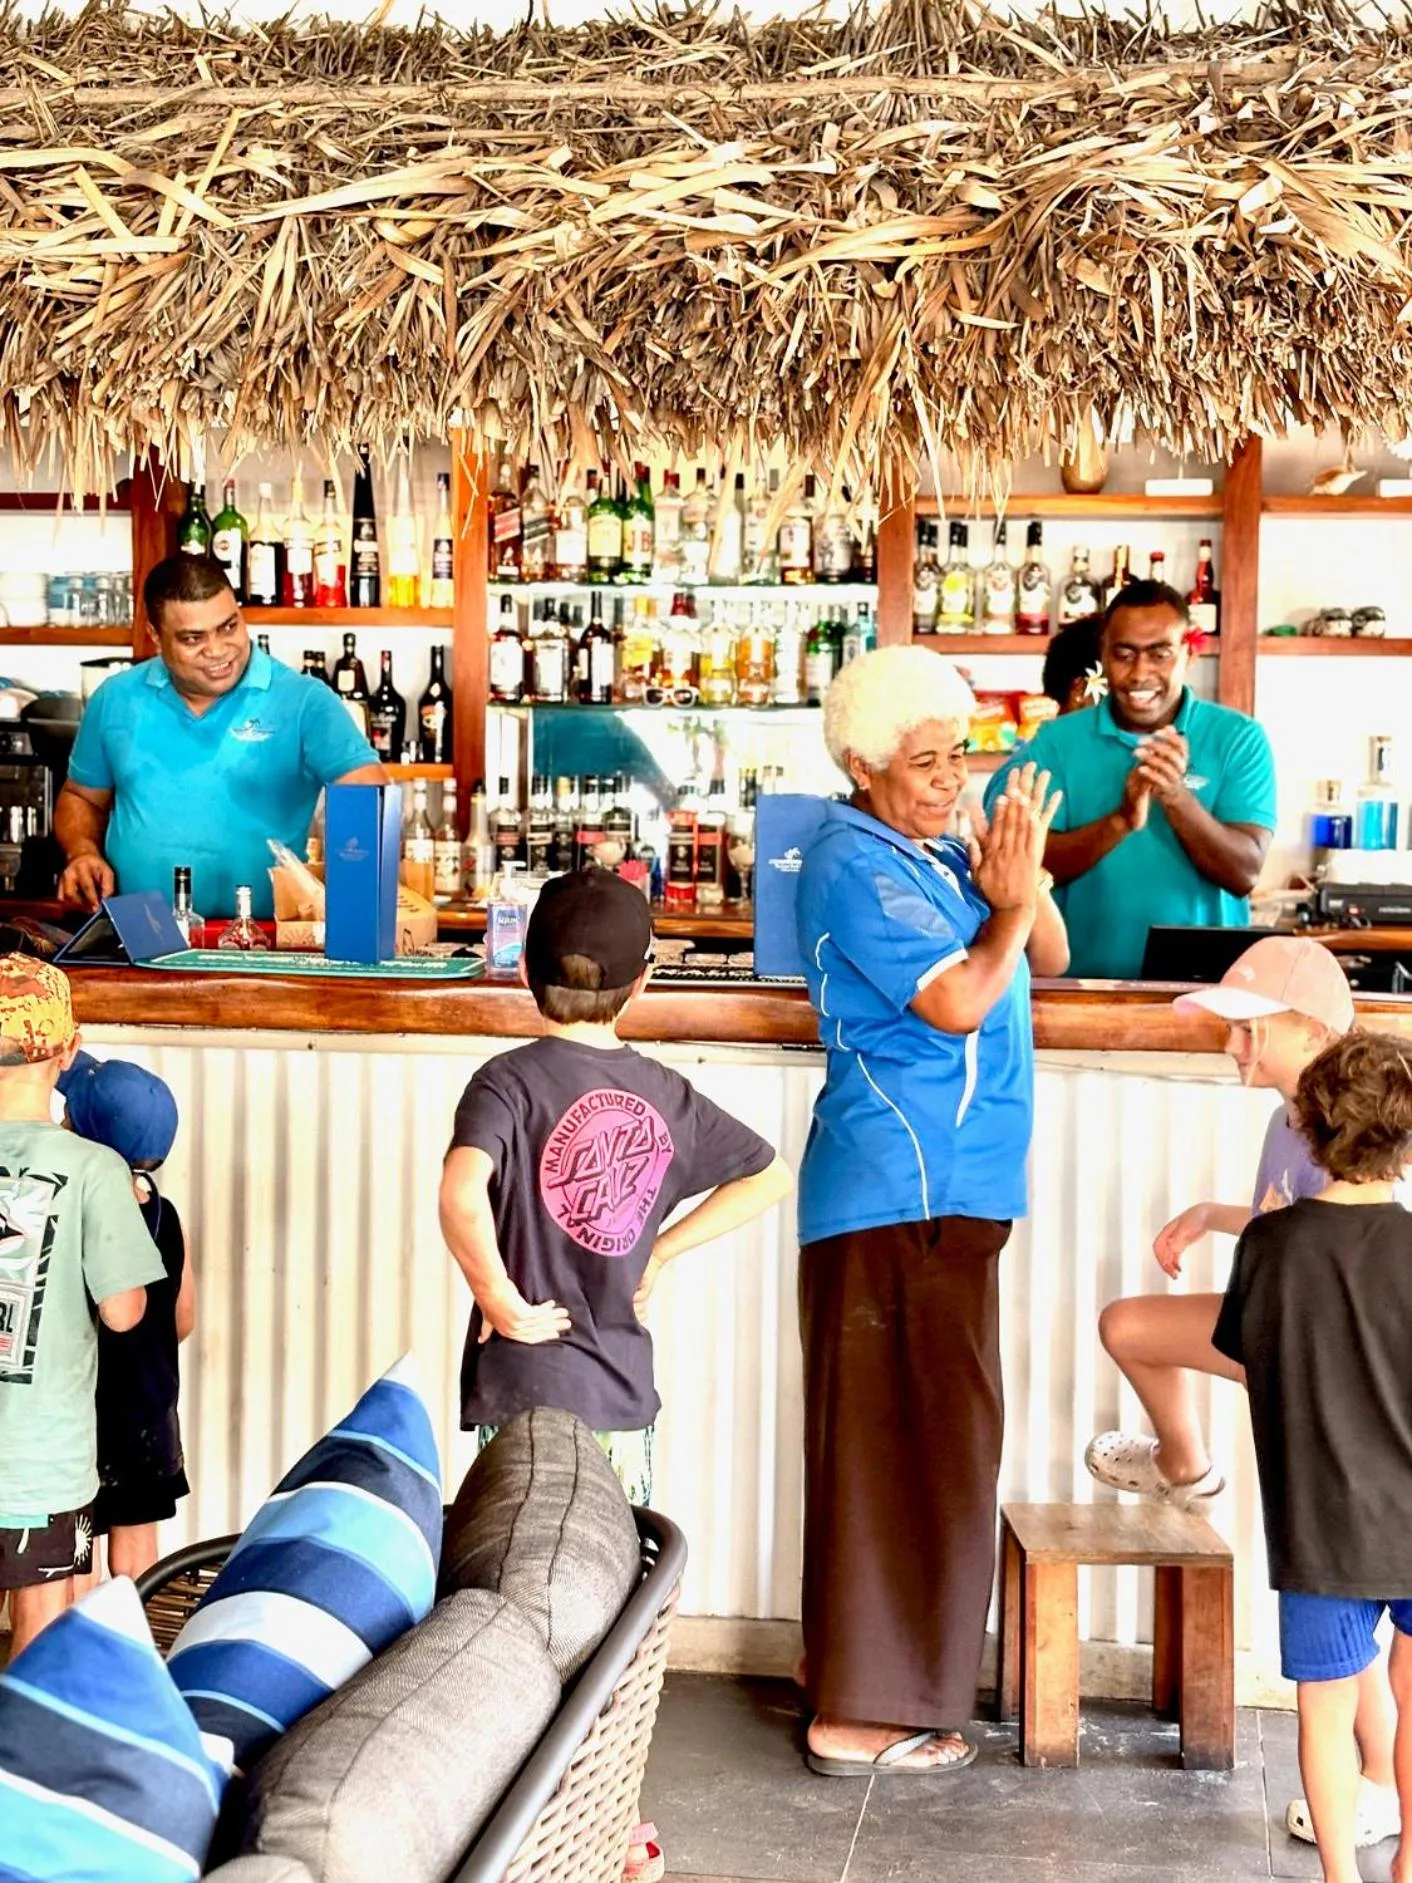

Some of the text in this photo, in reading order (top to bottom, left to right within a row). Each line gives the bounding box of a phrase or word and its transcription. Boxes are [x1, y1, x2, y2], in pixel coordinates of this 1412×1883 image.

[545, 1093, 672, 1173] MANUFACTURED BY
[547, 1115, 655, 1189] SANTA
